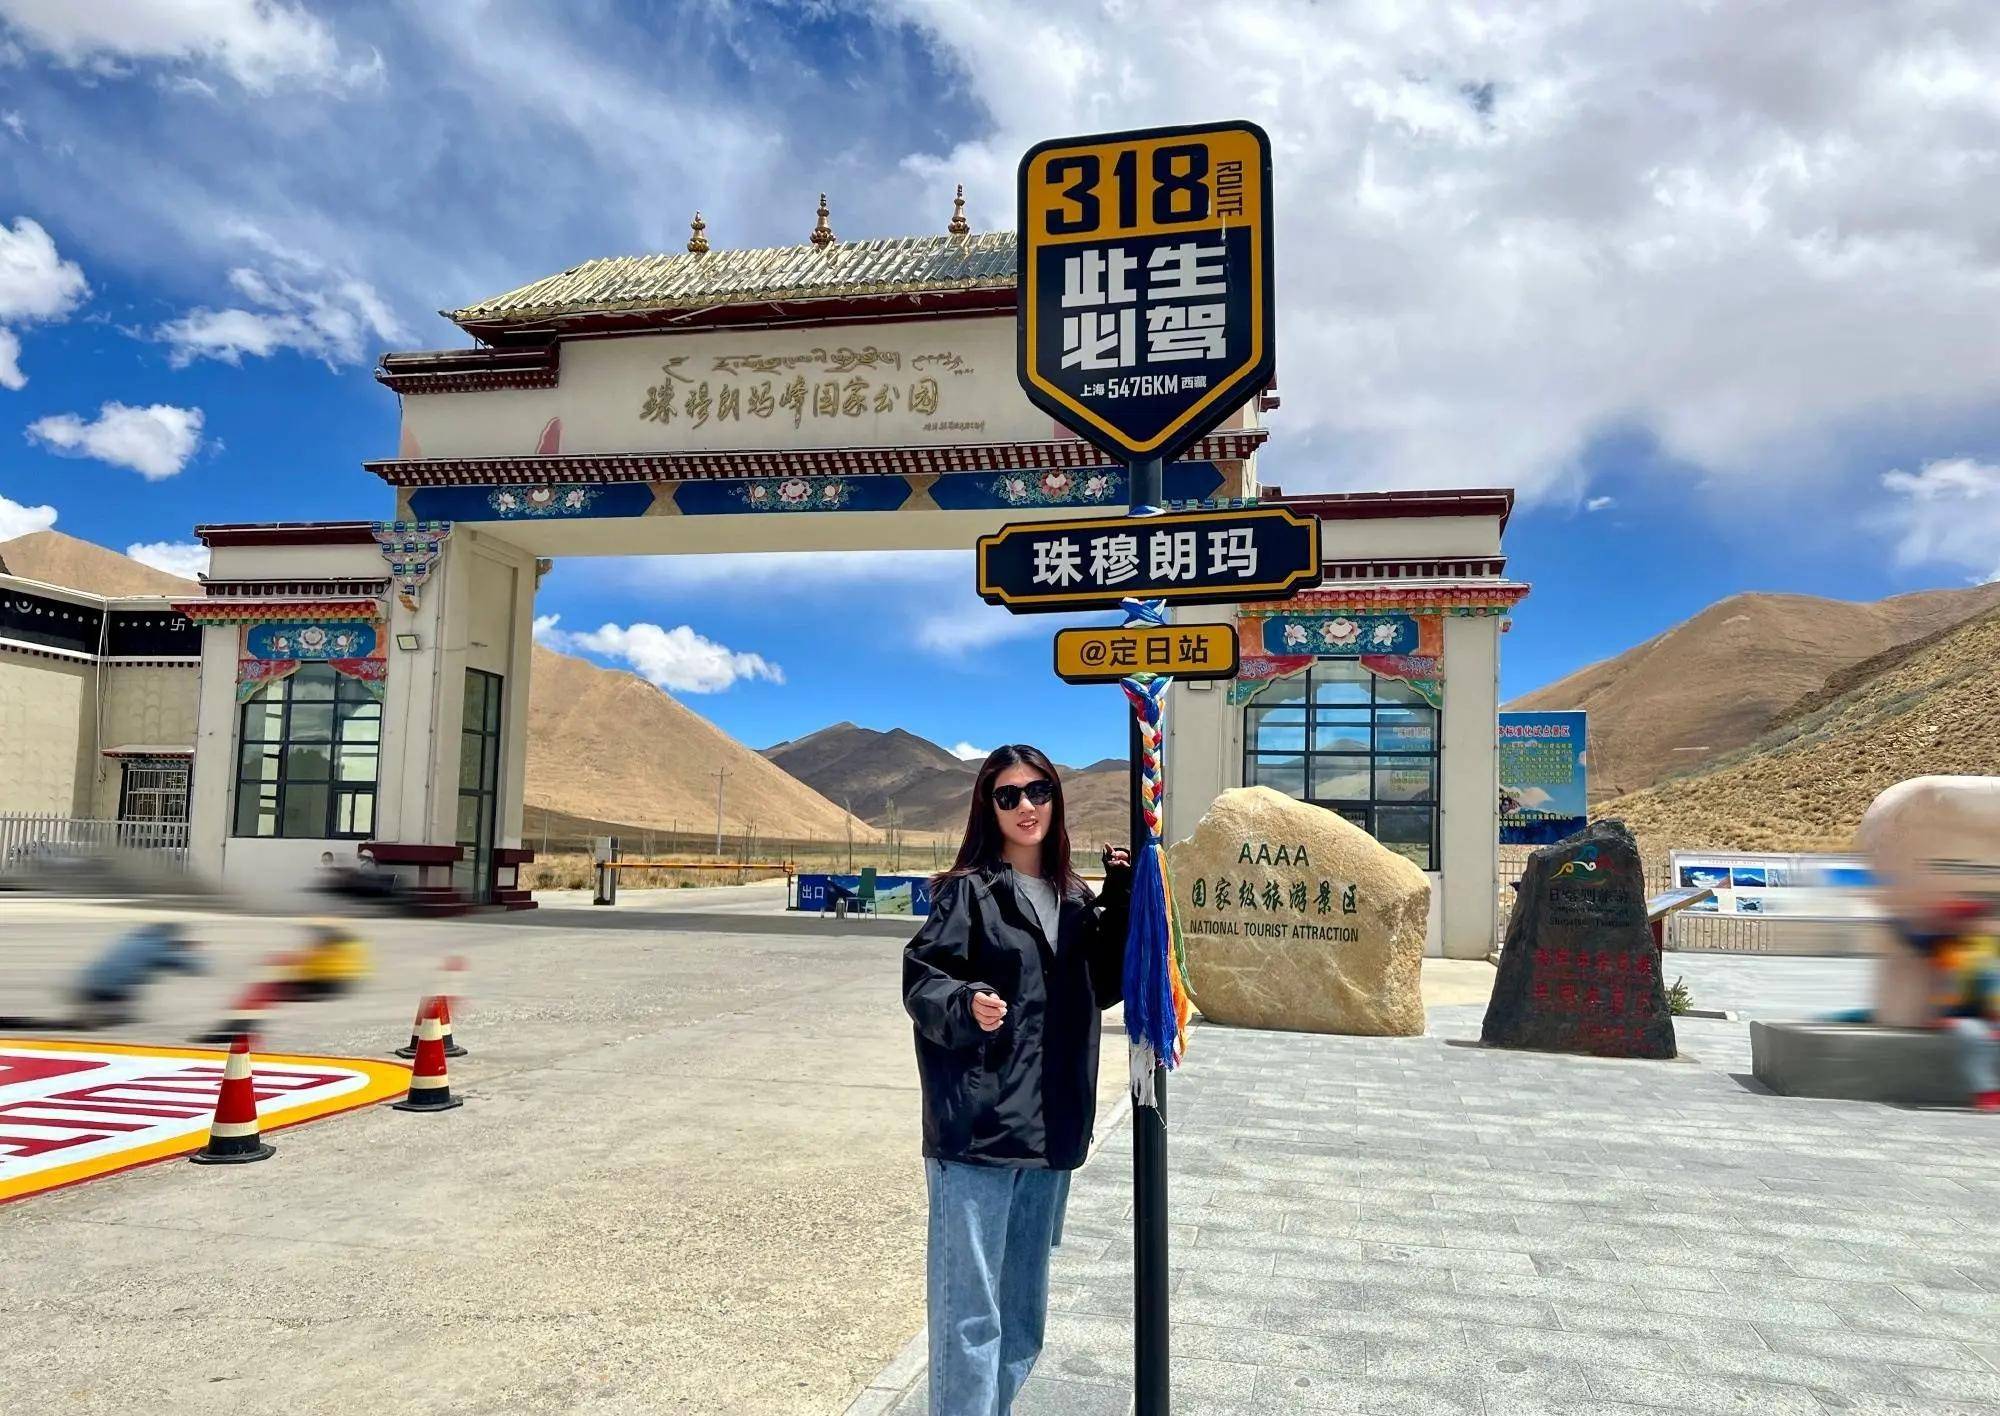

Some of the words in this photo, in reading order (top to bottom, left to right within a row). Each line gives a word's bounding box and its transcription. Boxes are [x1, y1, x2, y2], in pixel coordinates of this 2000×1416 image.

[1045, 143, 1211, 236] 318
[1216, 161, 1243, 218] ROUTE
[1061, 242, 1227, 308] 此生
[1061, 303, 1227, 371] 必驾
[1080, 382, 1105, 398] 上海
[1108, 374, 1178, 400] 5476KM
[1181, 375, 1207, 390] 西藏
[1032, 527, 1259, 587] 珠穆朗玛
[1080, 635, 1209, 667] @定日站
[1238, 843, 1310, 867] AAAA
[802, 884, 824, 900] 出口
[1191, 877, 1359, 916] 国家级旅游景区
[1190, 919, 1240, 936] NATIONAL
[1244, 922, 1288, 938] TOURIST
[1292, 924, 1359, 942] ATTRACTION
